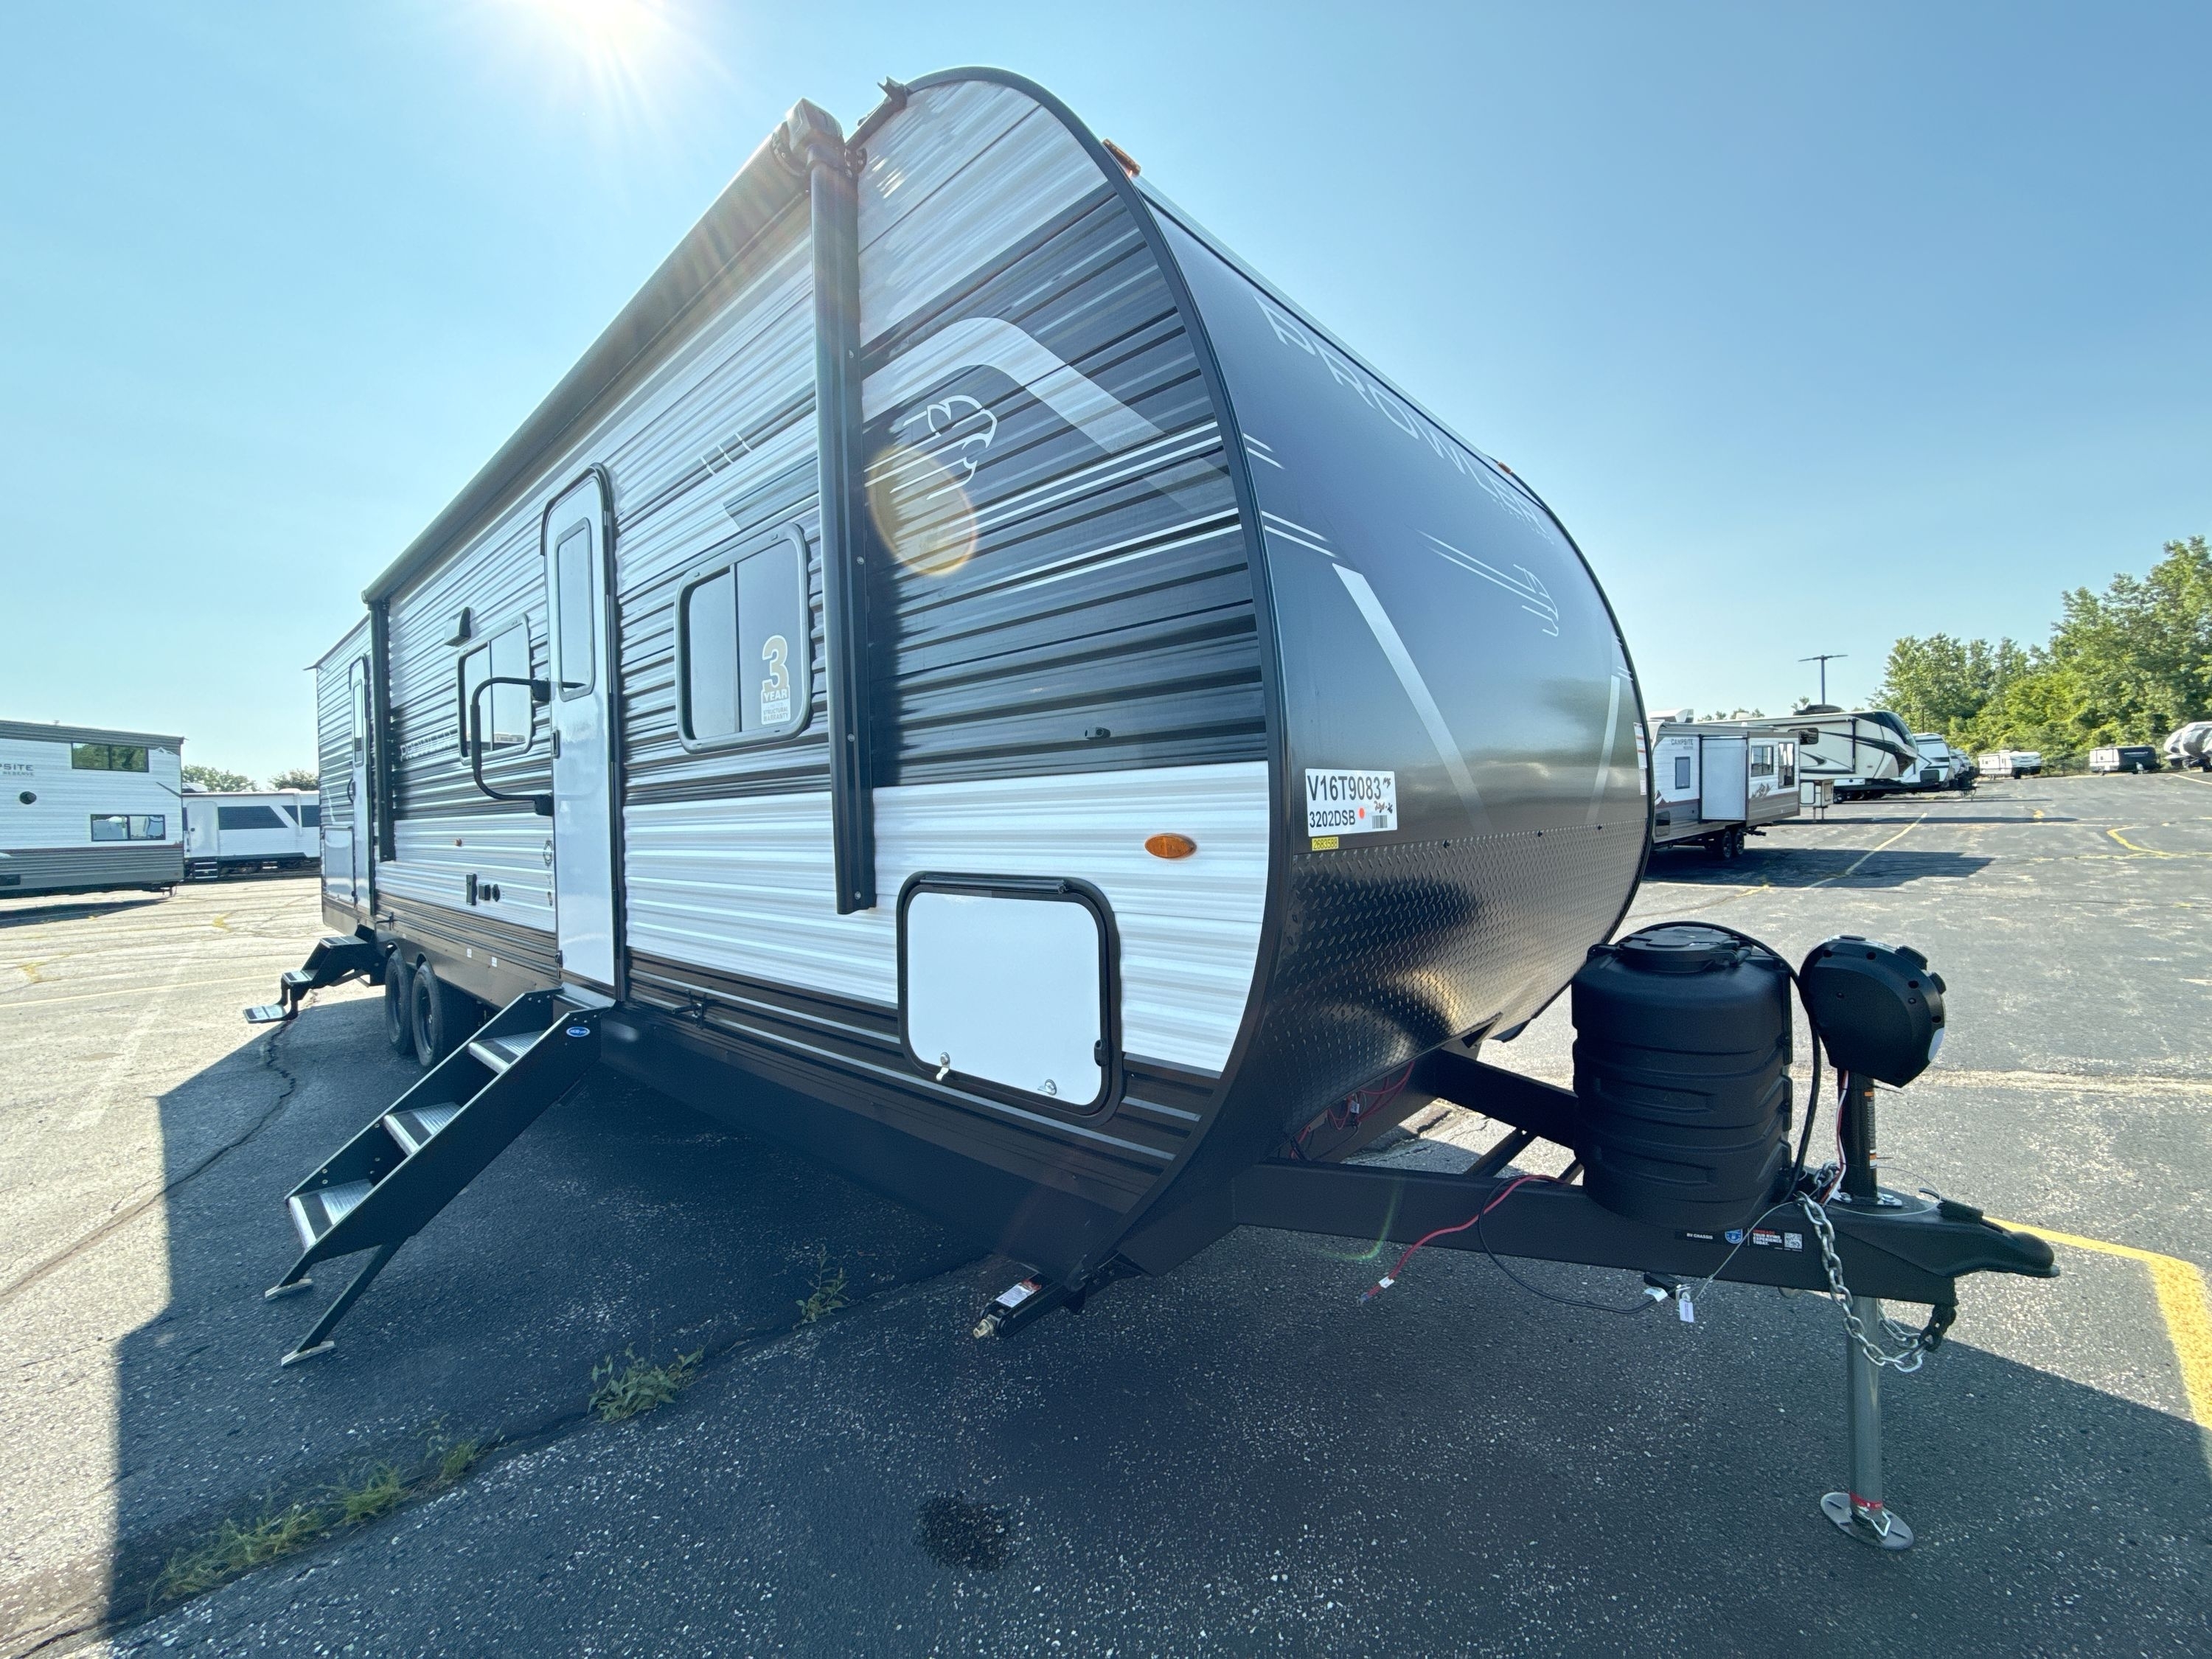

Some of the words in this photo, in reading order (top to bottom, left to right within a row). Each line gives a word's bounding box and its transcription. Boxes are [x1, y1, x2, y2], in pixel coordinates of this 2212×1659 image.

[762, 635, 789, 692] 3
[763, 689, 787, 702] YEAR
[1307, 775, 1382, 801] V16T9083
[1309, 810, 1356, 828] 3202DSB
